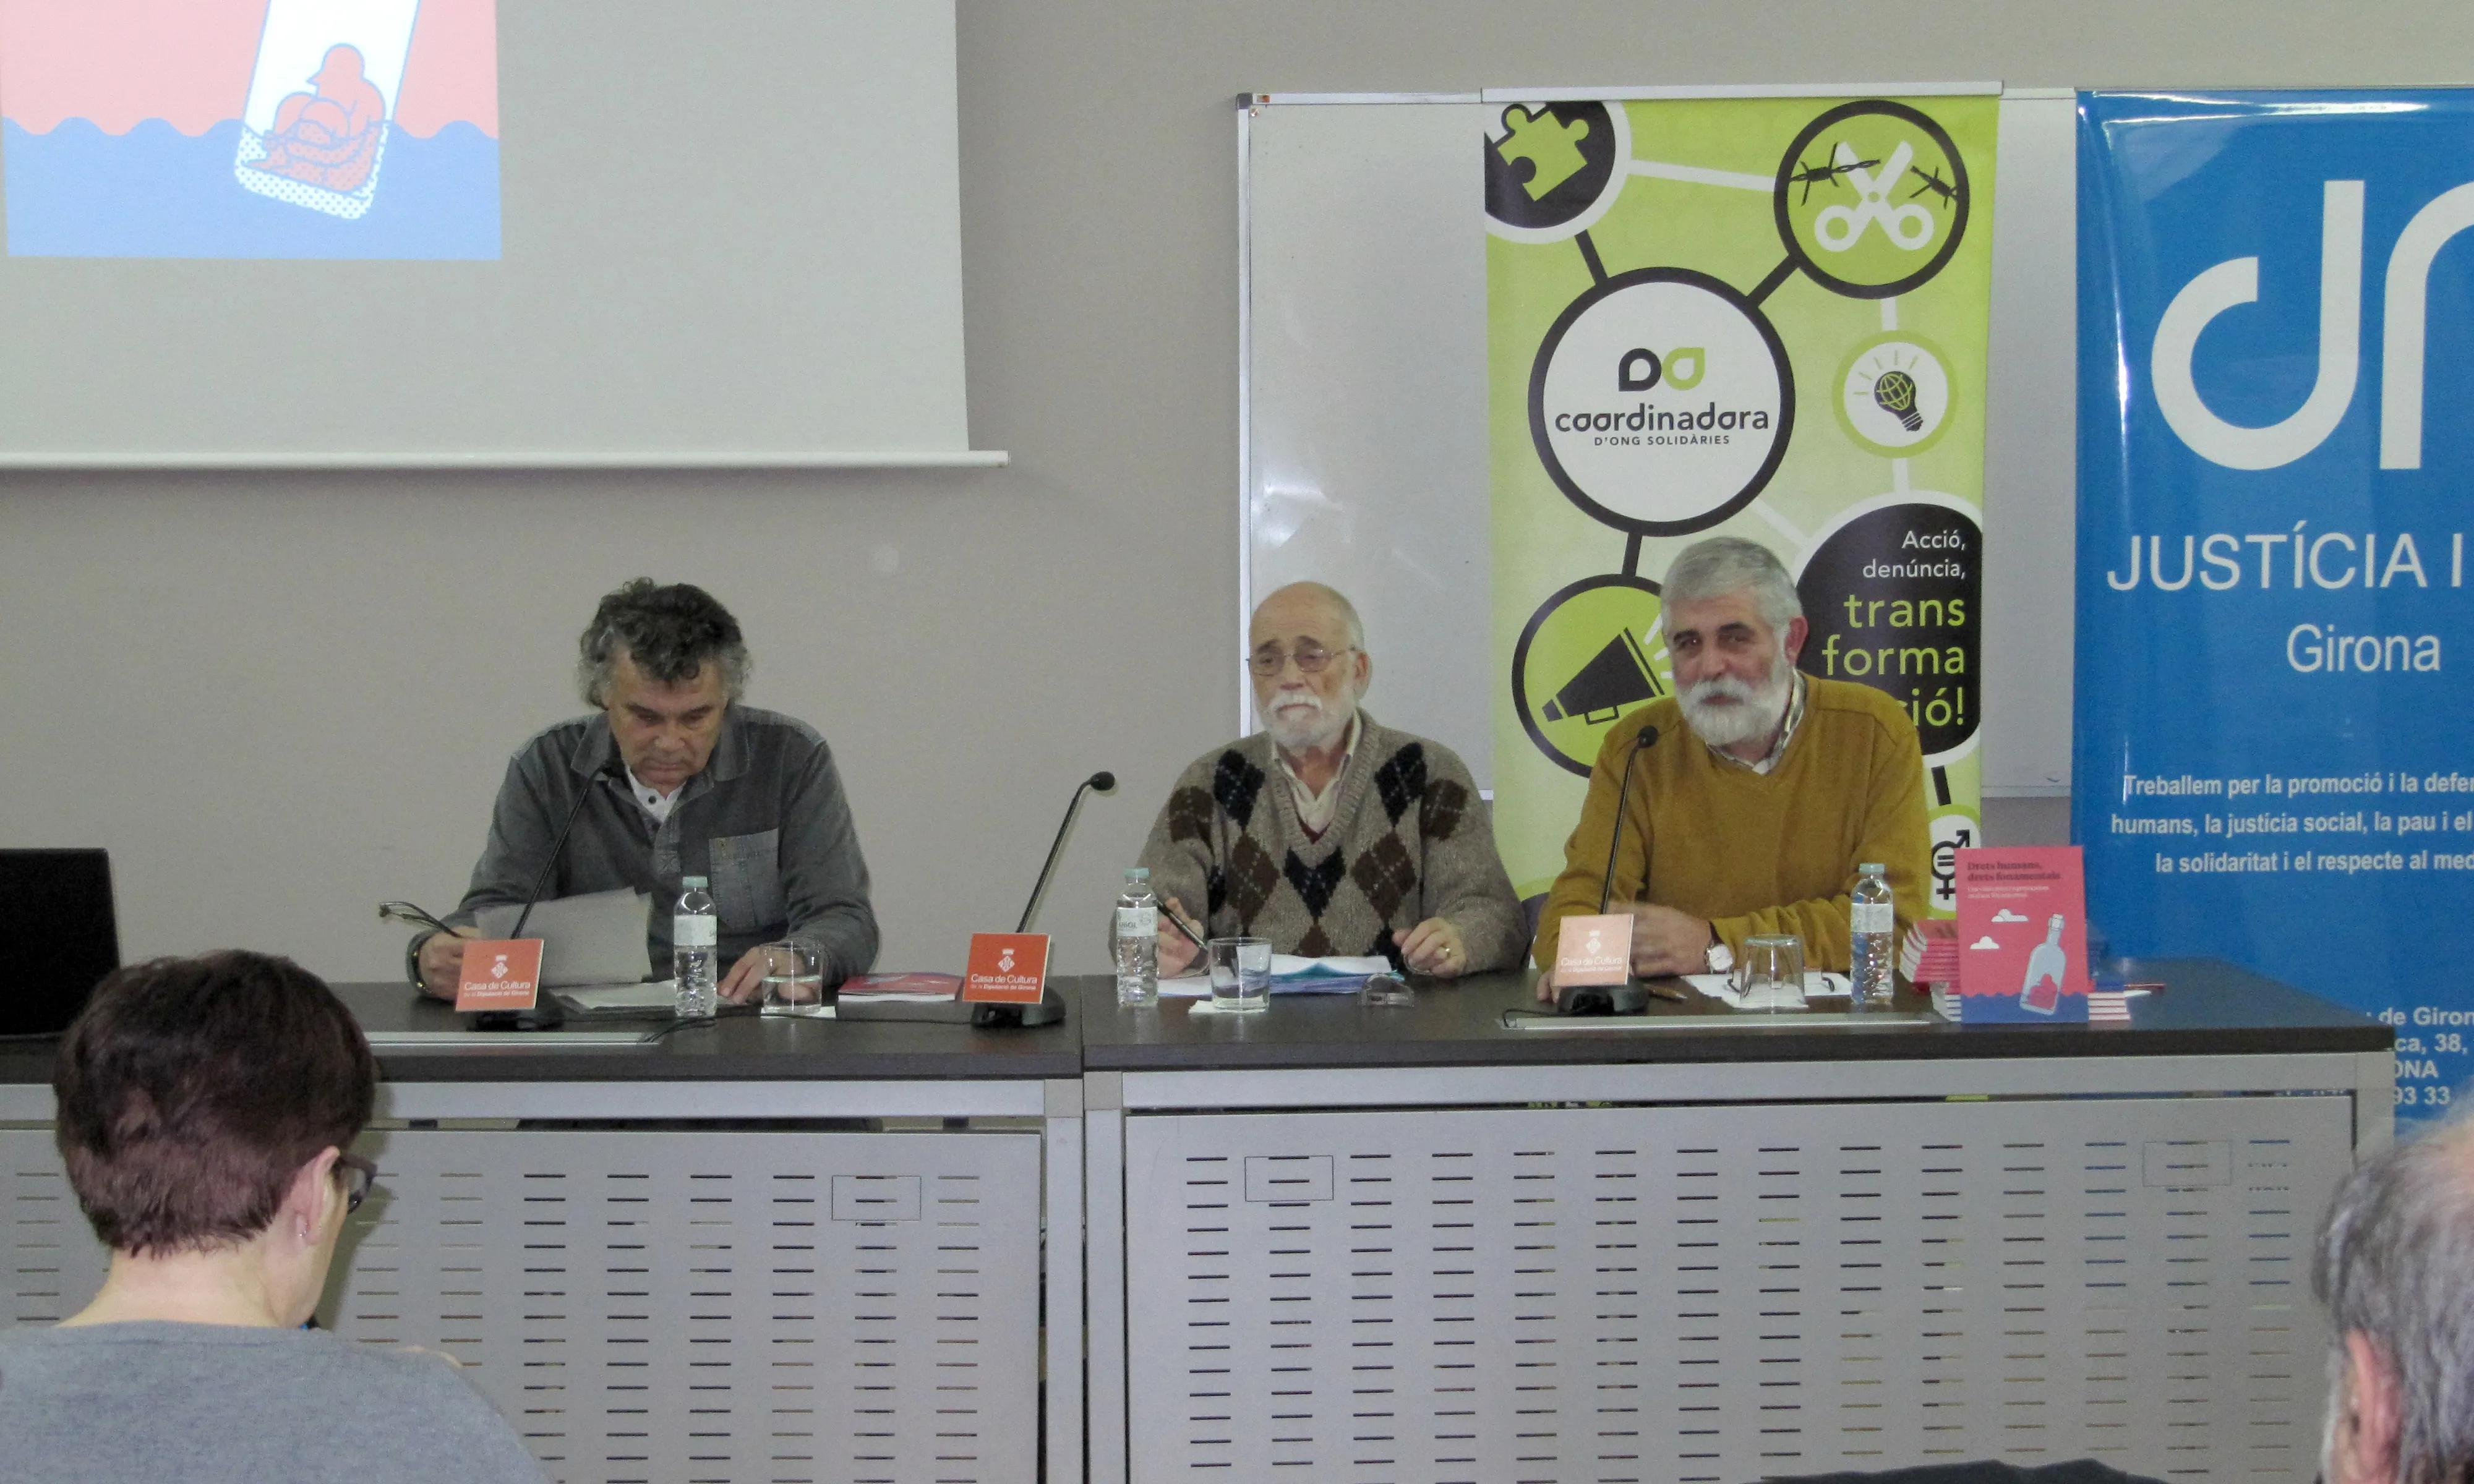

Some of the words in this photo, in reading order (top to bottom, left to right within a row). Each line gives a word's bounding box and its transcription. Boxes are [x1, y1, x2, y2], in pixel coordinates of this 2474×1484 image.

[1555, 403, 1769, 432] coordinadora
[1594, 436, 1641, 446] D'ONG
[1647, 433, 1730, 445] SOLIDÀRIES
[1901, 529, 1966, 551] Acció,
[2107, 520, 2428, 591] JUSTÍCIA
[2452, 532, 2463, 587] I
[1862, 558, 1966, 580] denúncia,
[1843, 594, 1966, 628] trans
[1821, 634, 1965, 676] forma
[2286, 623, 2441, 672] Girona
[1898, 686, 1964, 727] ió!
[2123, 774, 2222, 796] Treballem
[2228, 778, 2261, 800] per
[2266, 774, 2282, 795] la
[2288, 772, 2382, 798] promoció
[2389, 772, 2394, 793] i
[2400, 772, 2418, 793] la
[2110, 813, 2198, 837] humans,
[2204, 813, 2222, 834] la
[2227, 812, 2298, 838] justícia
[2303, 811, 2368, 835] social,
[2374, 811, 2392, 831] la
[2398, 815, 2436, 835] pau
[2442, 811, 2448, 831] i
[2454, 811, 2473, 831] el
[2155, 852, 2173, 873] la
[2178, 851, 2278, 873] solidaritat
[2283, 851, 2289, 871] i
[2294, 850, 2312, 871] el
[2318, 851, 2403, 875] respecte
[2410, 850, 2428, 870] al
[464, 981, 487, 991] Casa
[488, 981, 500, 989] de
[500, 980, 531, 989] Cultura
[971, 974, 993, 983] Casa
[995, 974, 1006, 983] de
[1007, 974, 1038, 984] Cultura
[2378, 1007, 2407, 1026] de
[2434, 1033, 2468, 1056] 38,
[2423, 1086, 2451, 1106] 33
